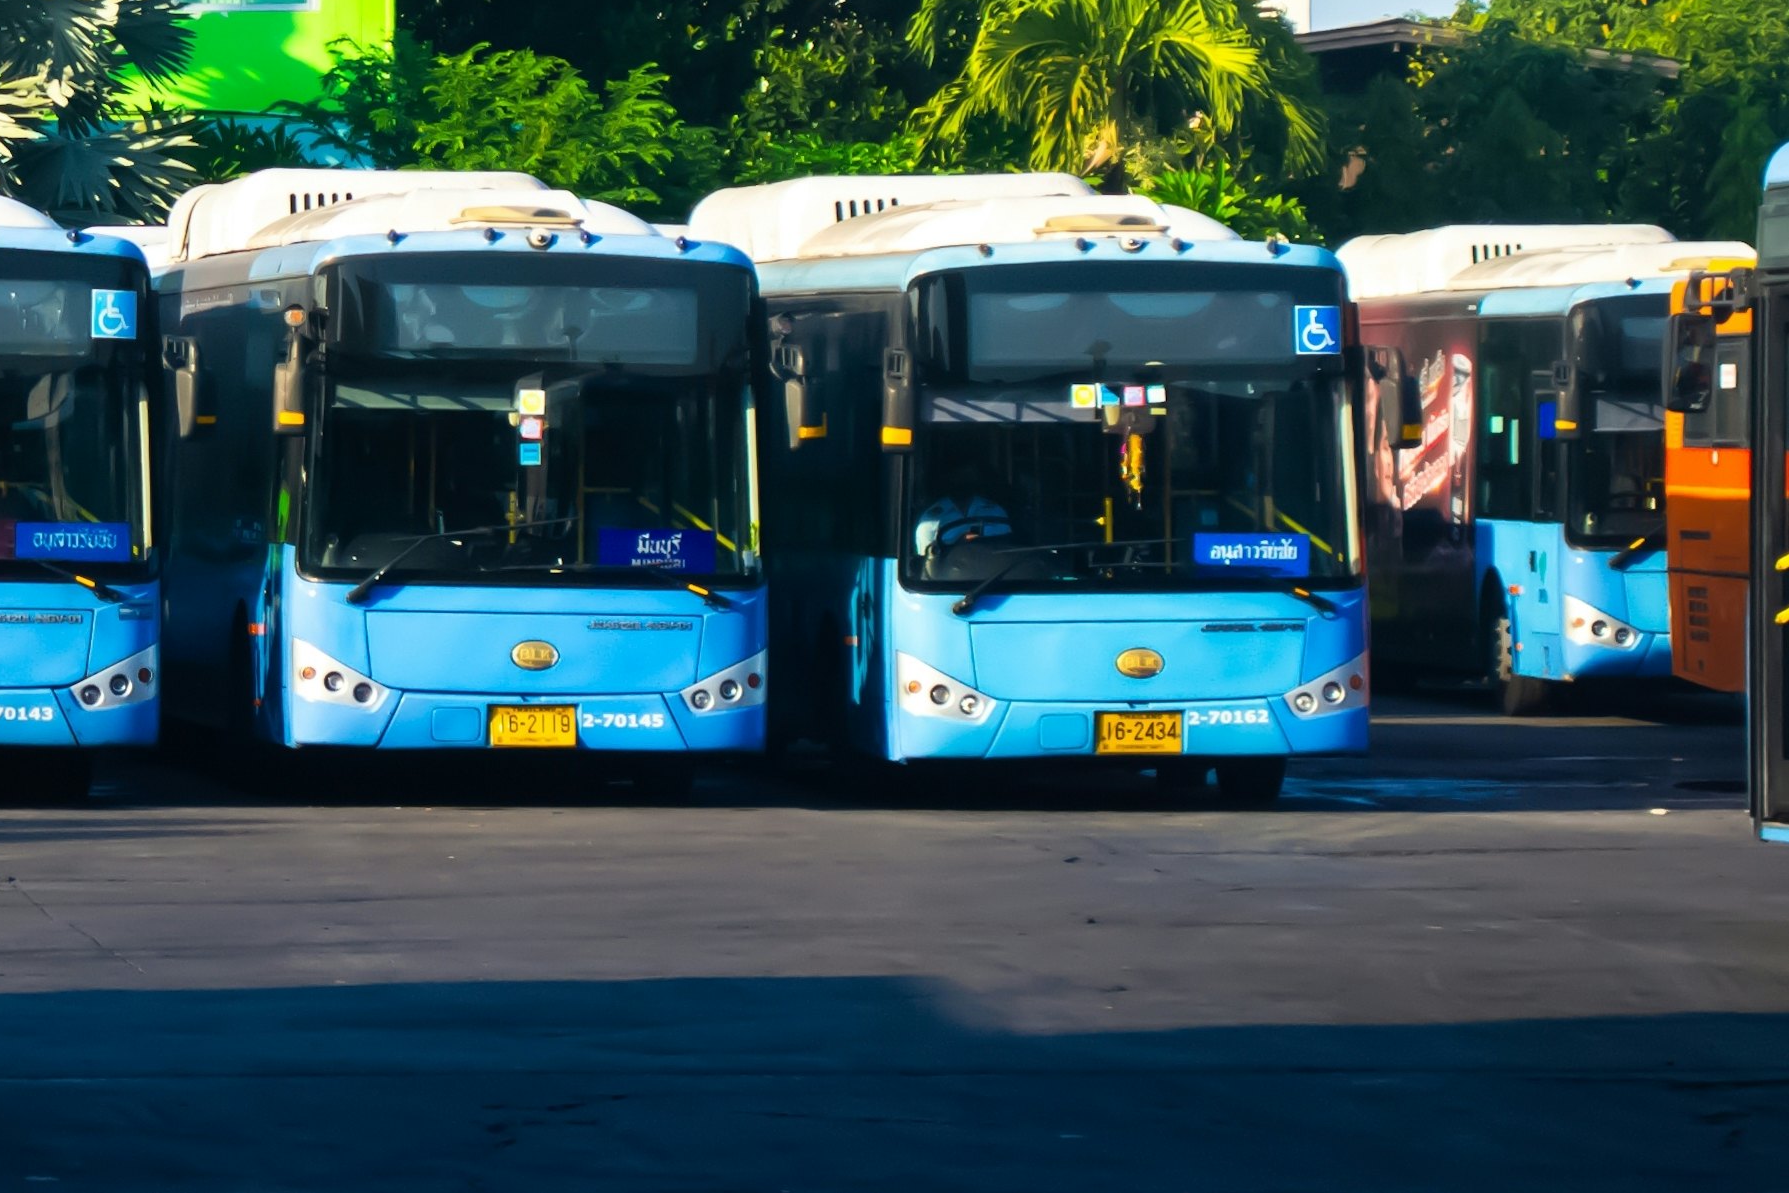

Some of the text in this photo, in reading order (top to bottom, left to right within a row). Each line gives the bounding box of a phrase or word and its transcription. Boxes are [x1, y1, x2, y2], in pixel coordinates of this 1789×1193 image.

[636, 532, 682, 559] มีนบุรี
[501, 714, 571, 733] 16-2119
[583, 713, 664, 728] 2-70145
[1188, 709, 1269, 725] 2-70162
[1107, 721, 1177, 741] 16-2434
